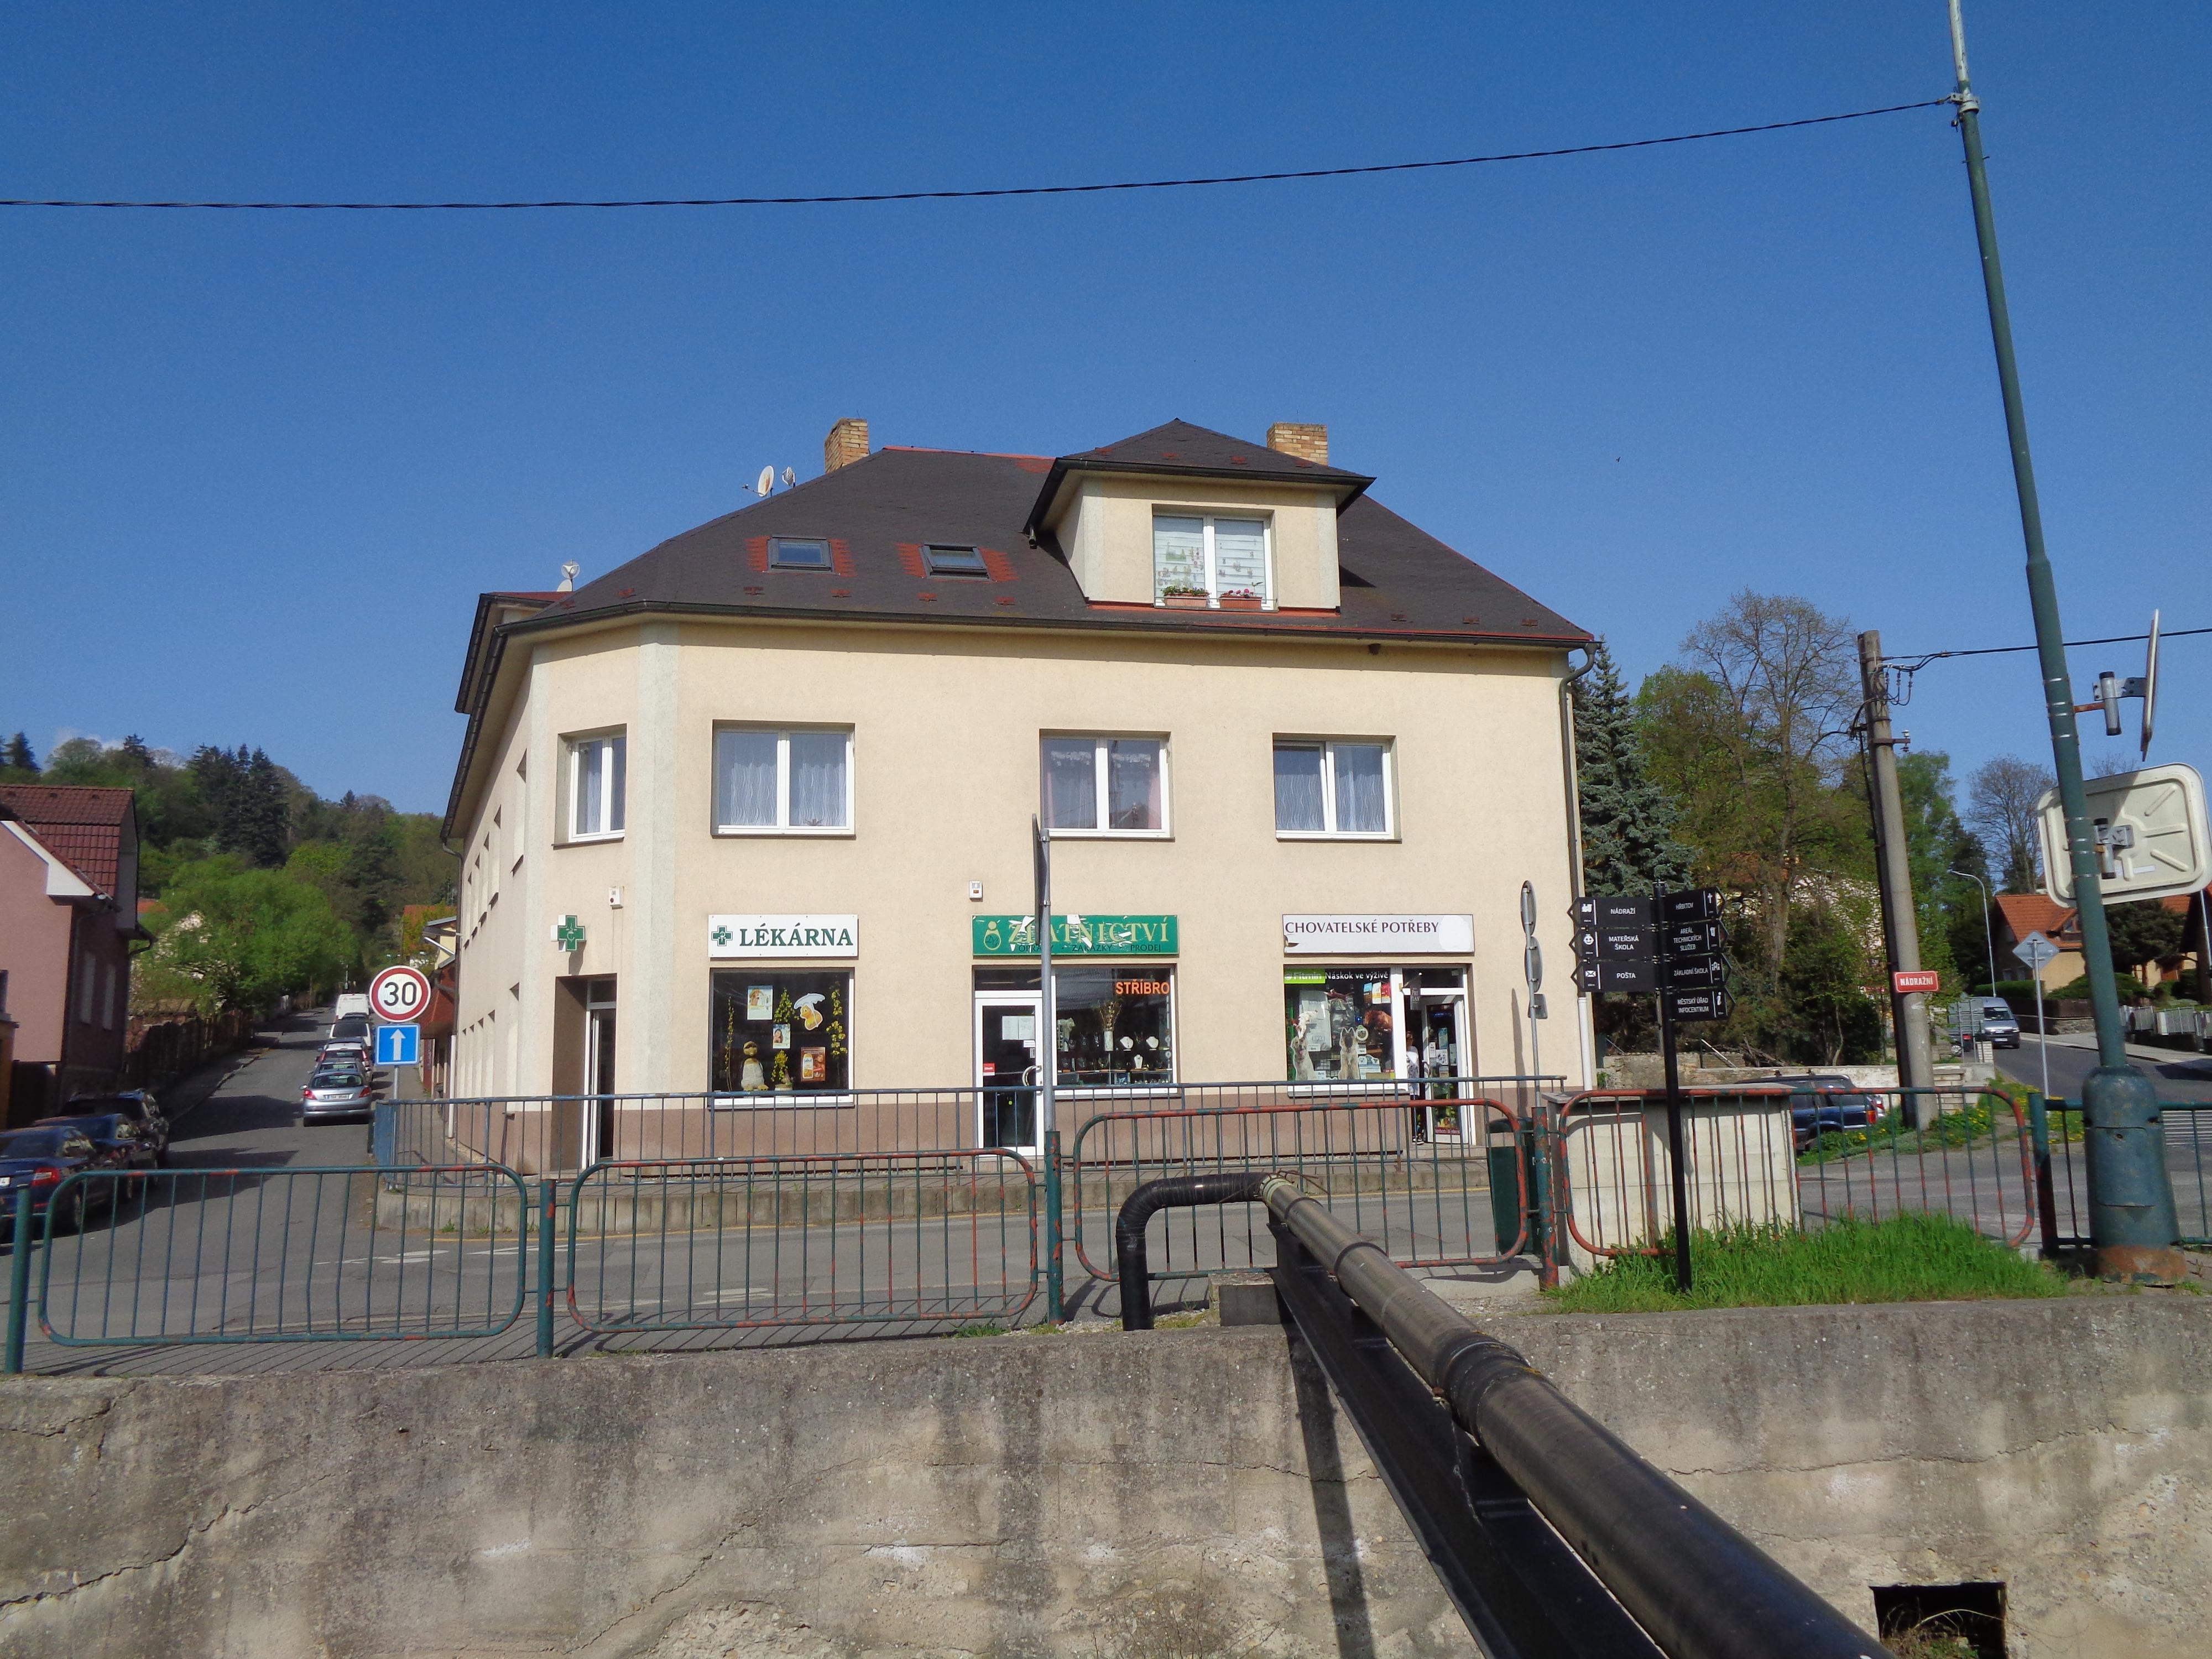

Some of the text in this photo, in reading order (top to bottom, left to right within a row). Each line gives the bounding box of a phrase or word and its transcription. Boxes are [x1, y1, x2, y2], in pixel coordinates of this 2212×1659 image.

[1285, 919, 1438, 933] CHOVATELSKÉ POTŘEBY
[739, 922, 853, 946] LÉKÁRNA
[1673, 935, 1702, 943] TECHNICKÝCH
[1130, 944, 1161, 952] PRODEJ
[1366, 972, 1388, 980] výživě
[1674, 968, 1694, 976] ZÁKLADNÍ
[1900, 976, 1933, 985] NÁDRAŽNÍ
[1116, 979, 1170, 994] STŘÍBRO
[384, 982, 417, 1006] 30
